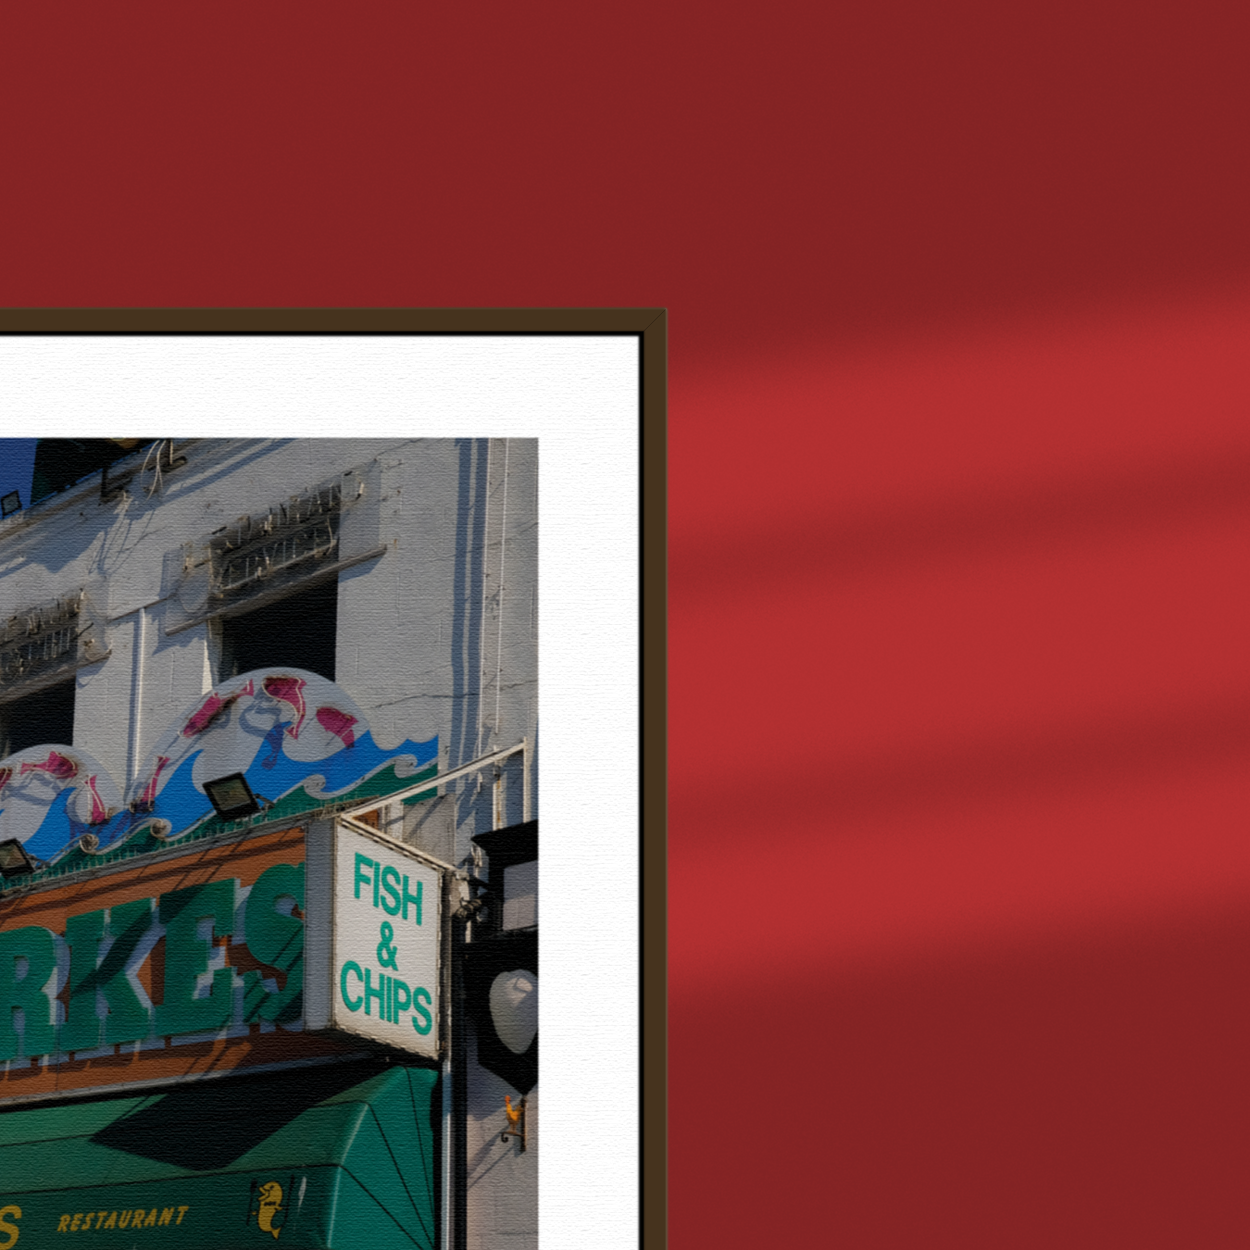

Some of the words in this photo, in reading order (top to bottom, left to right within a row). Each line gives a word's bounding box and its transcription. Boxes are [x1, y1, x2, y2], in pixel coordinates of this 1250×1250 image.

[354, 852, 422, 926] FISH
[376, 921, 399, 972] &
[340, 960, 432, 1036] CHIPS
[56, 1205, 189, 1233] RESTAURANT
